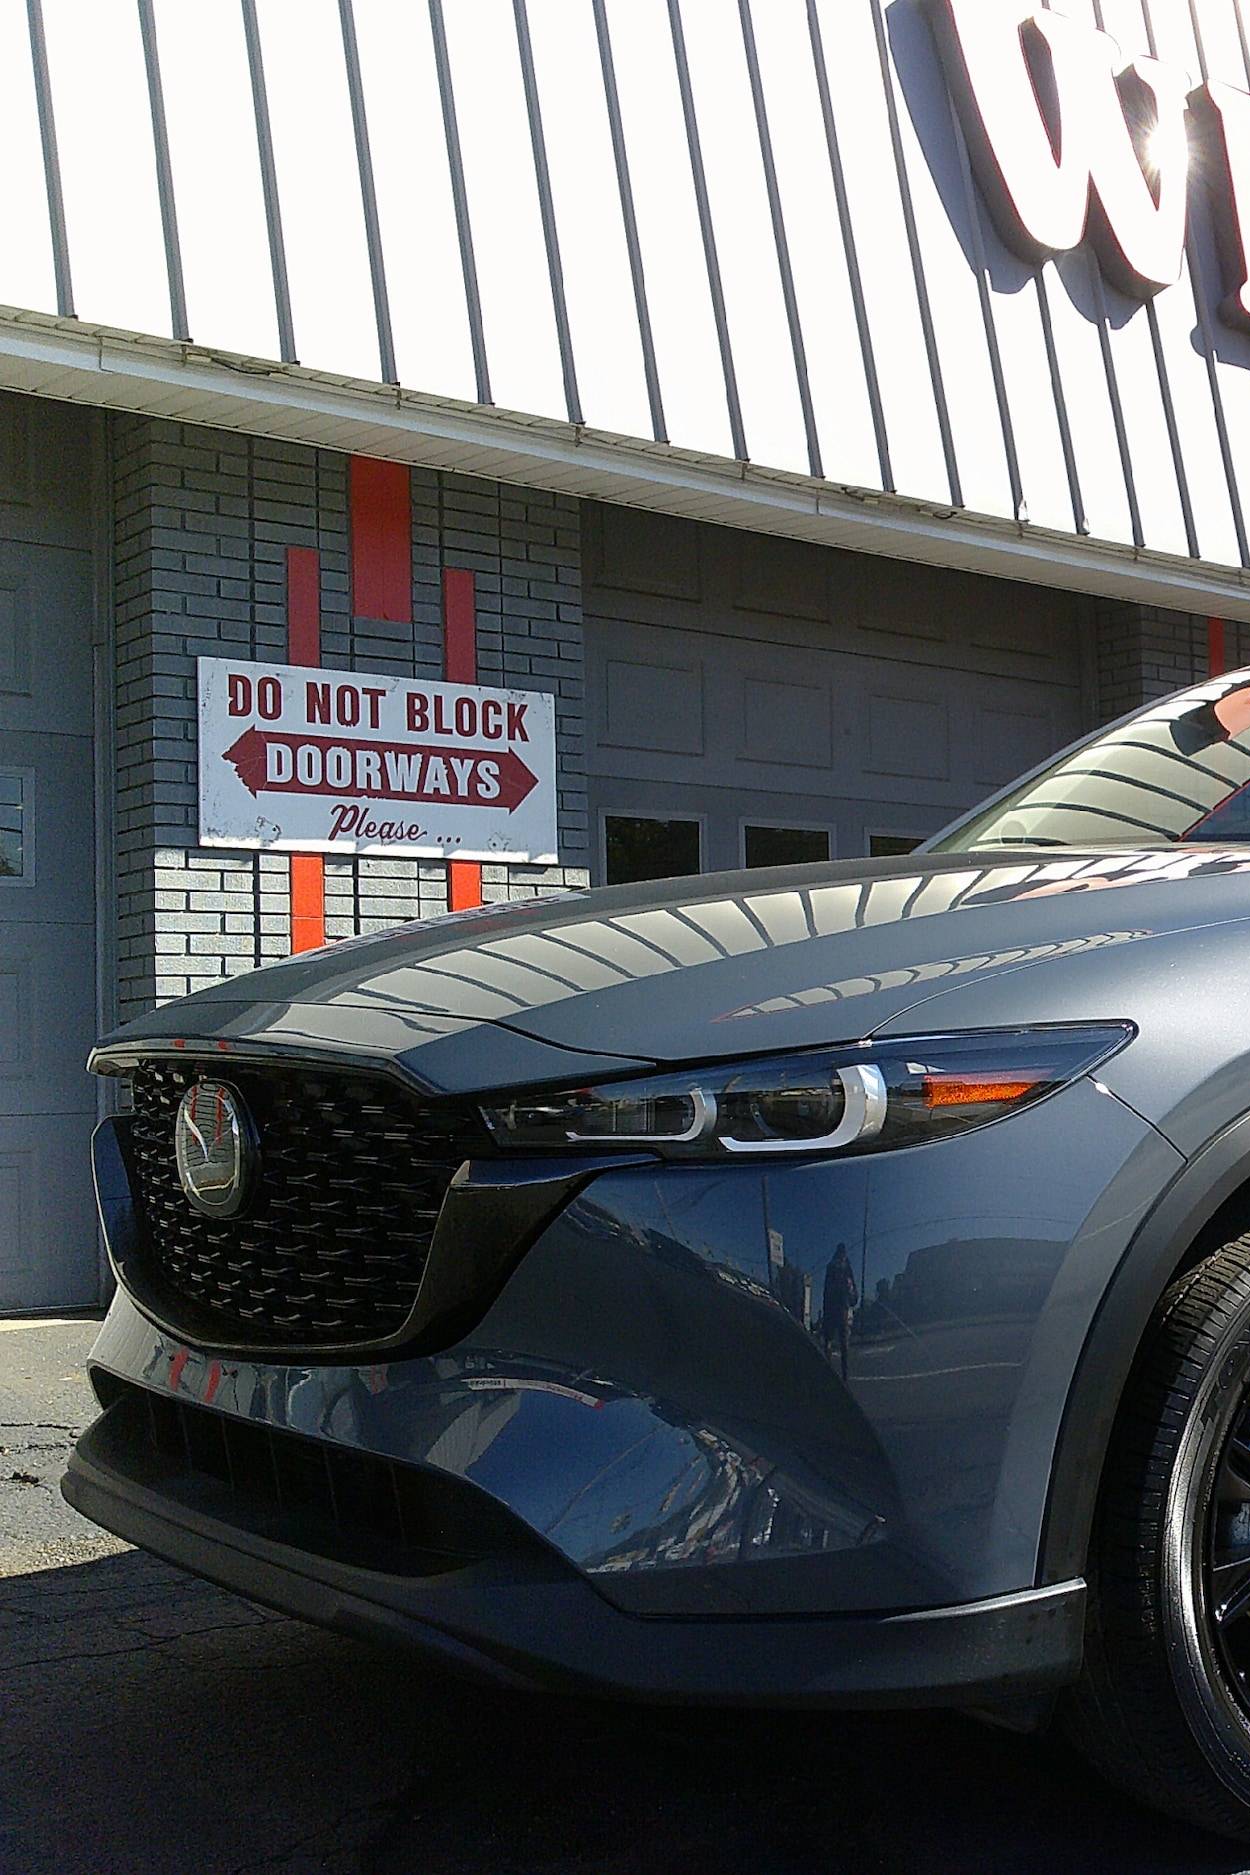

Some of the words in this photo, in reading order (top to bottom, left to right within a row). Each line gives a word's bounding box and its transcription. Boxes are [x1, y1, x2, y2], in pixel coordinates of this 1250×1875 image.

[227, 673, 283, 721] DO
[305, 681, 387, 730] NOT
[406, 691, 531, 743] BLOCK
[264, 741, 502, 800] DOORWAYS
[328, 803, 428, 842] Please
